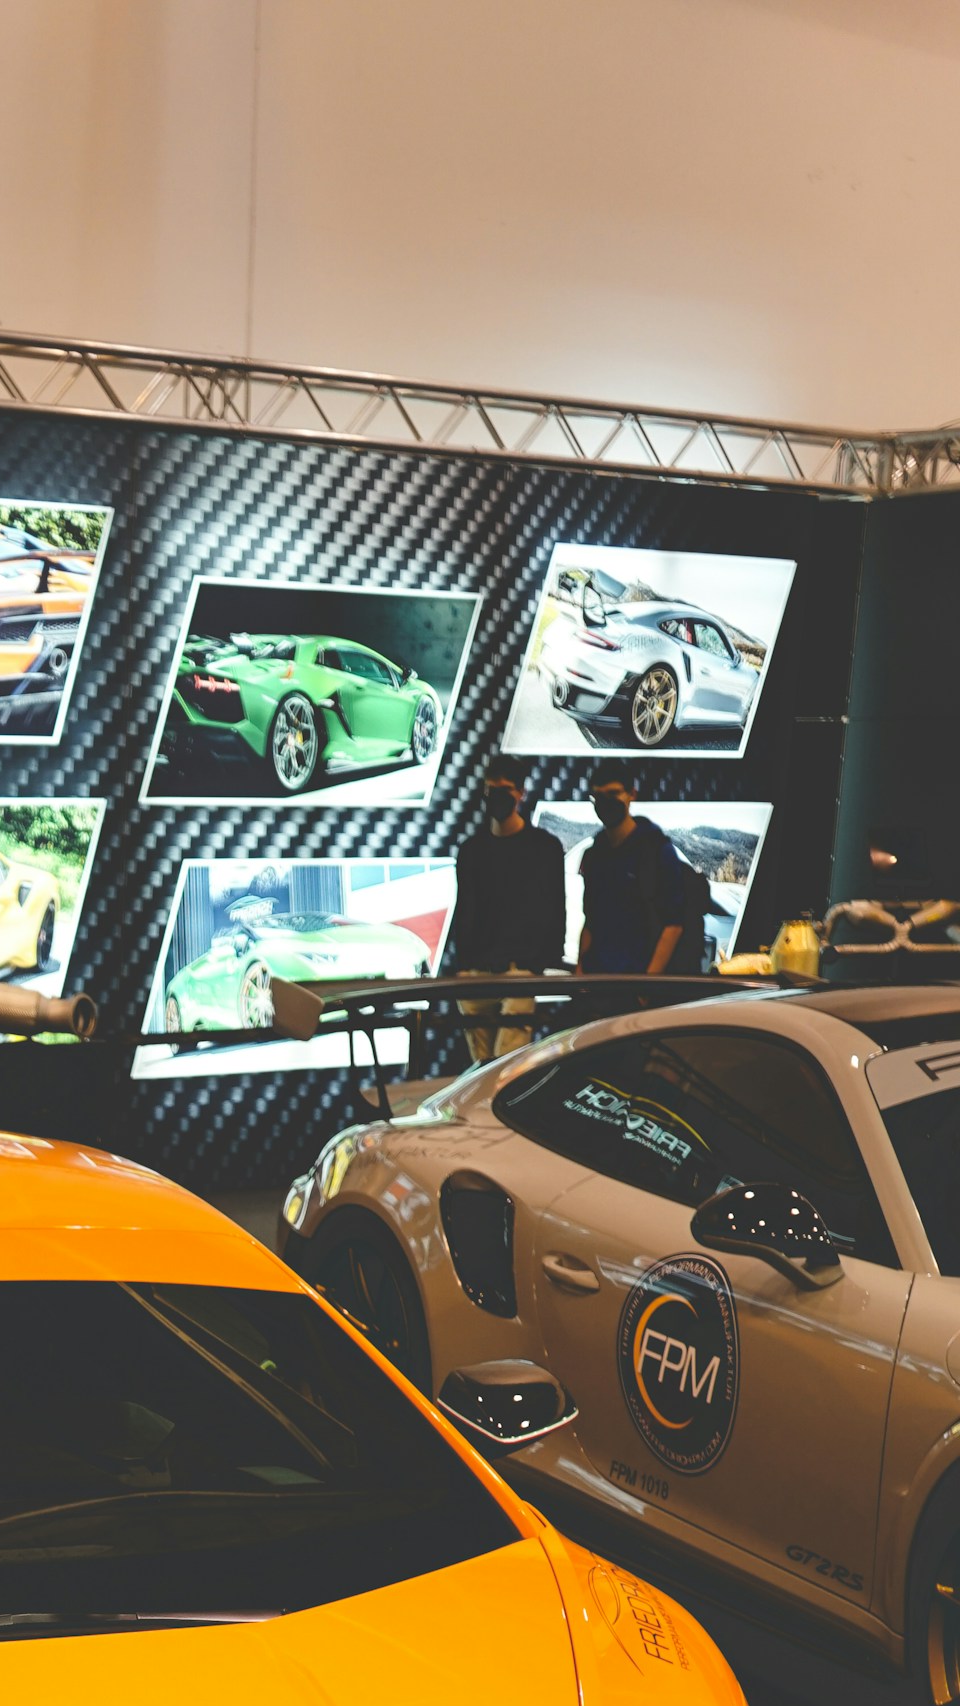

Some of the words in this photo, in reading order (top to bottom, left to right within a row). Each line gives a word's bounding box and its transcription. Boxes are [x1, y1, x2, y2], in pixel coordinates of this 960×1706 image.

[637, 1328, 721, 1404] FPM
[609, 1459, 637, 1487] FPM
[641, 1472, 670, 1500] 1018
